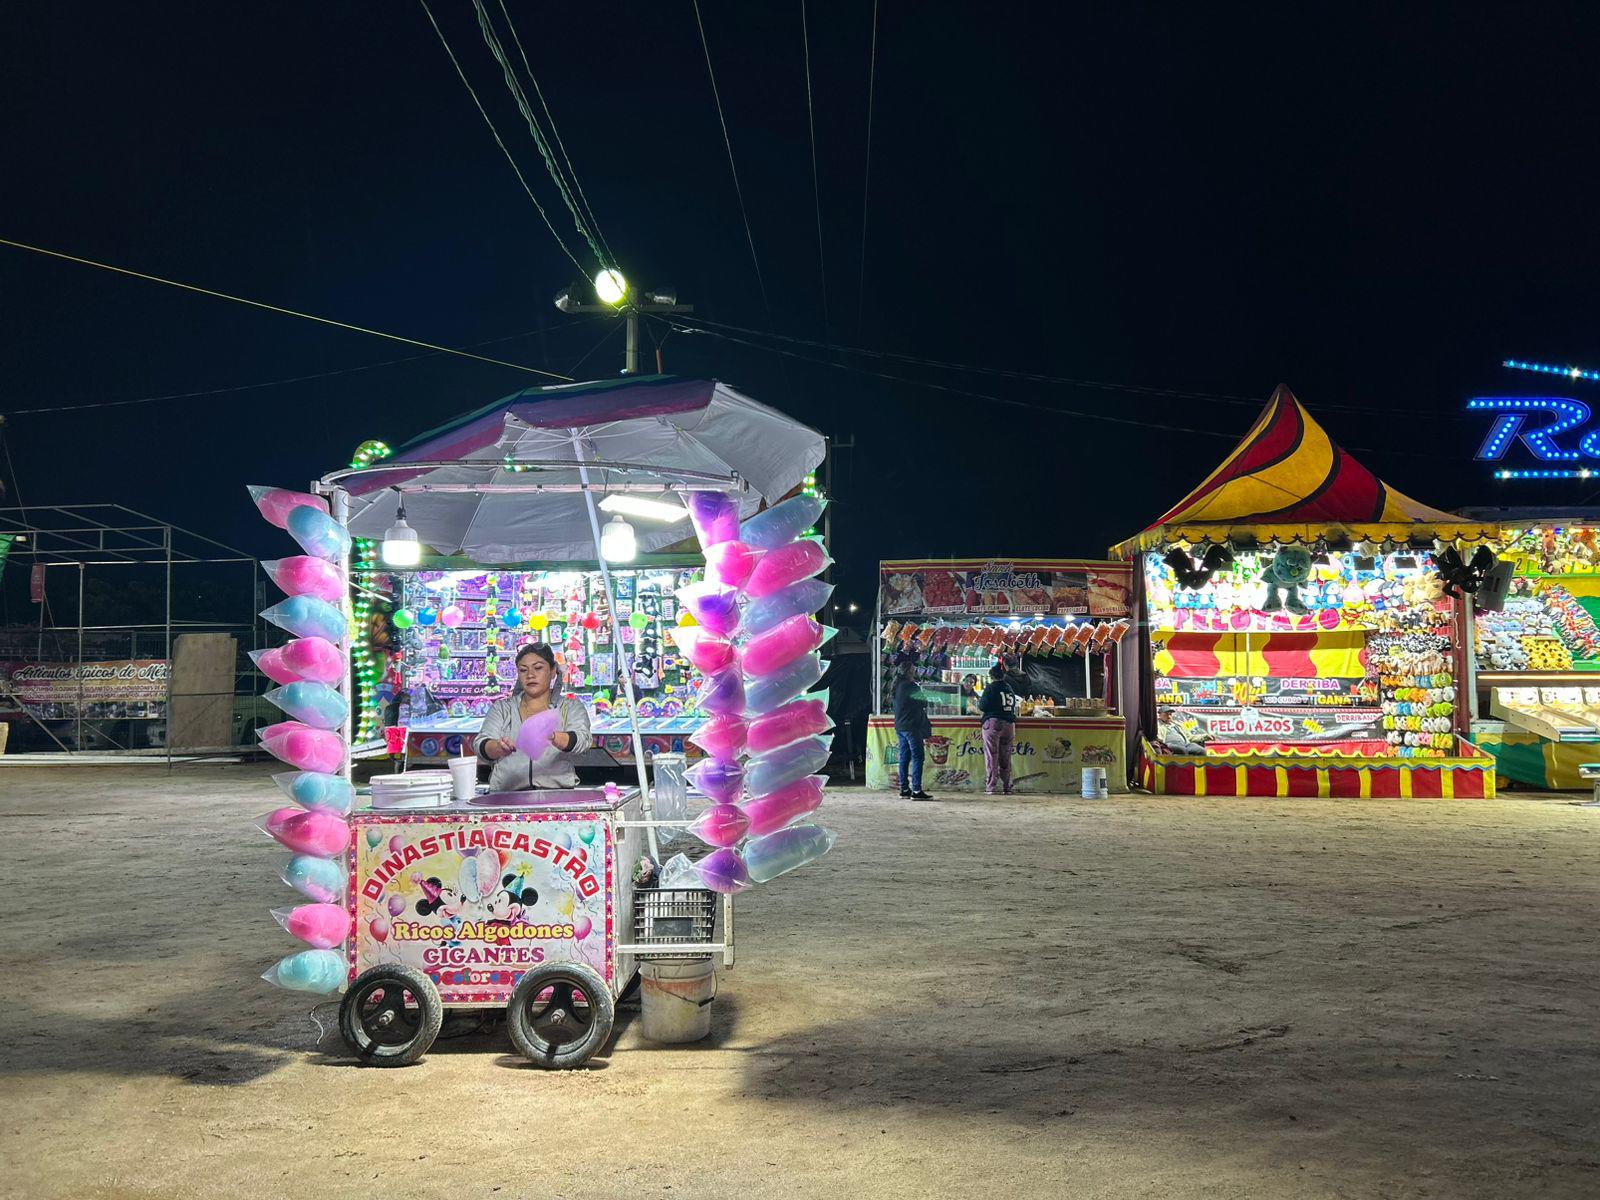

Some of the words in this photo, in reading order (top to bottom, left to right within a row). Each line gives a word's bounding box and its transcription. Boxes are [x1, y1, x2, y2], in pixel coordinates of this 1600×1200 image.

[1516, 558, 1523, 570] 2
[119, 664, 136, 679] de
[1282, 680, 1339, 689] DERRIBA
[1000, 692, 1013, 706] 15
[362, 825, 487, 901] DINASTÍA
[493, 830, 600, 897] CASTRO
[393, 922, 454, 941] Ricos
[458, 921, 574, 943] Algodones
[422, 947, 545, 965] GIGANTES
